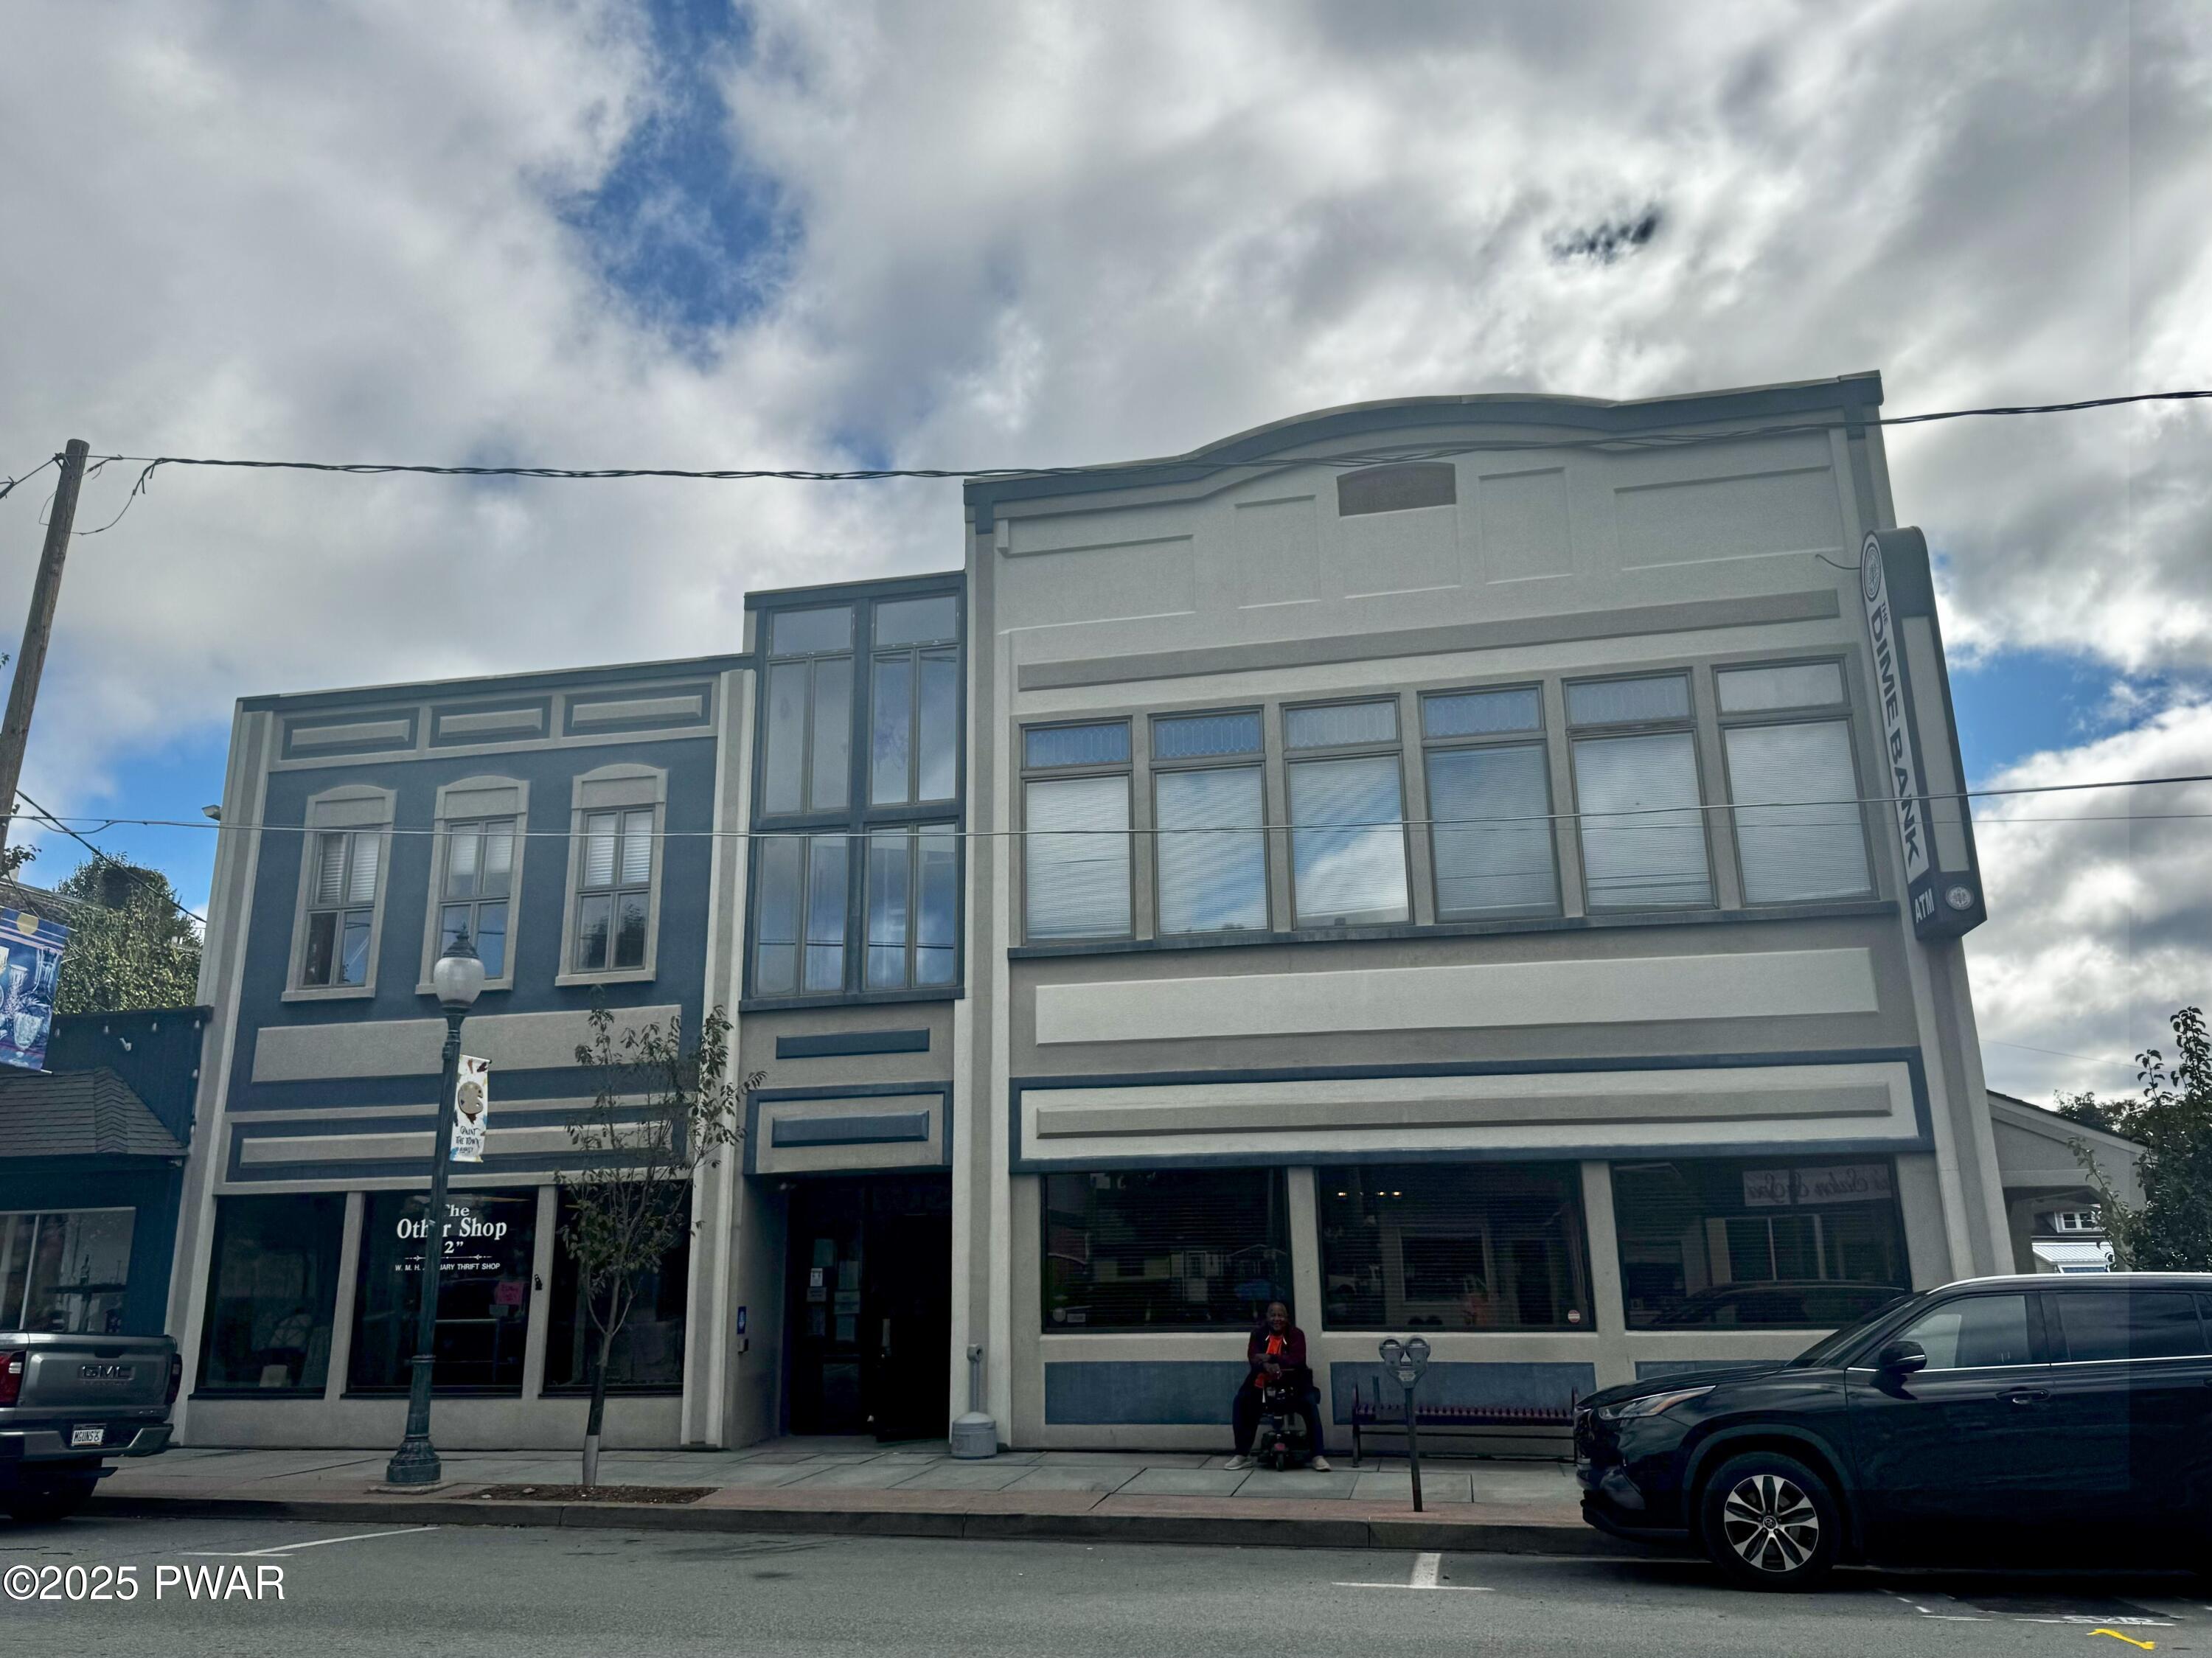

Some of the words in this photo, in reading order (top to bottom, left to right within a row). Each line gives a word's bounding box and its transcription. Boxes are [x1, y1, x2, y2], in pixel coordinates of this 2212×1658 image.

[1871, 605, 1899, 728] DIME
[1889, 727, 1920, 868] BANK
[1916, 888, 1935, 924] ATM
[445, 1204, 470, 1216] he
[397, 1218, 451, 1239] Othr
[459, 1216, 507, 1240] Shop
[81, 1365, 131, 1379] GMC
